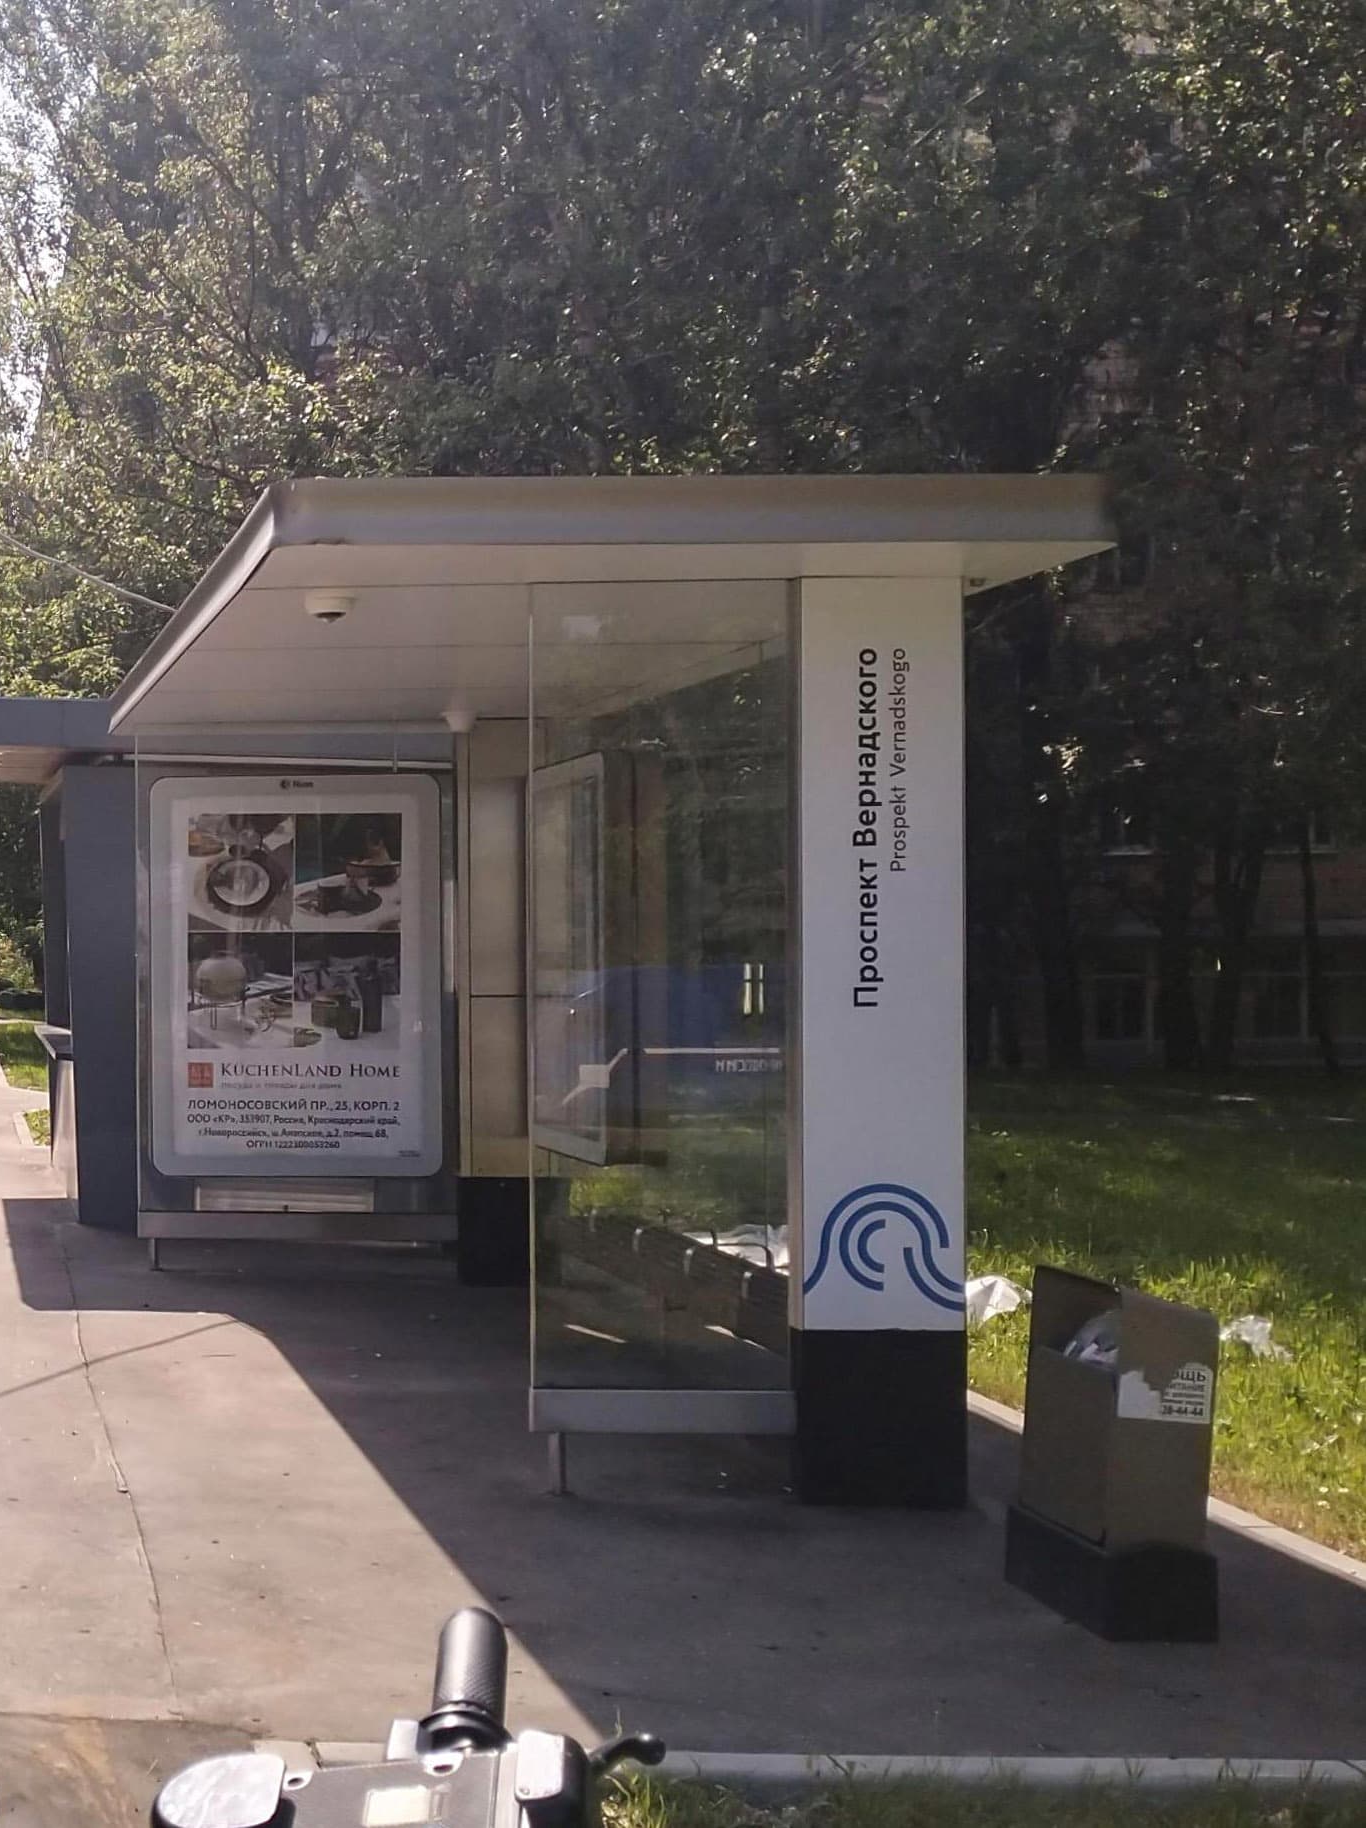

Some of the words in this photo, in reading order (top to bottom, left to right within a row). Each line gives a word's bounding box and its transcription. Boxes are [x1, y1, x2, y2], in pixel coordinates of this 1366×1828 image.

[853, 648, 882, 847] Вернадского
[889, 648, 910, 777] Vernadskogo
[889, 786, 910, 872] Prospekt
[853, 859, 884, 1007] Проспект
[187, 1099, 307, 1111] ЛОМОНОСОВСКИЙ
[187, 1114, 211, 1123] ООО
